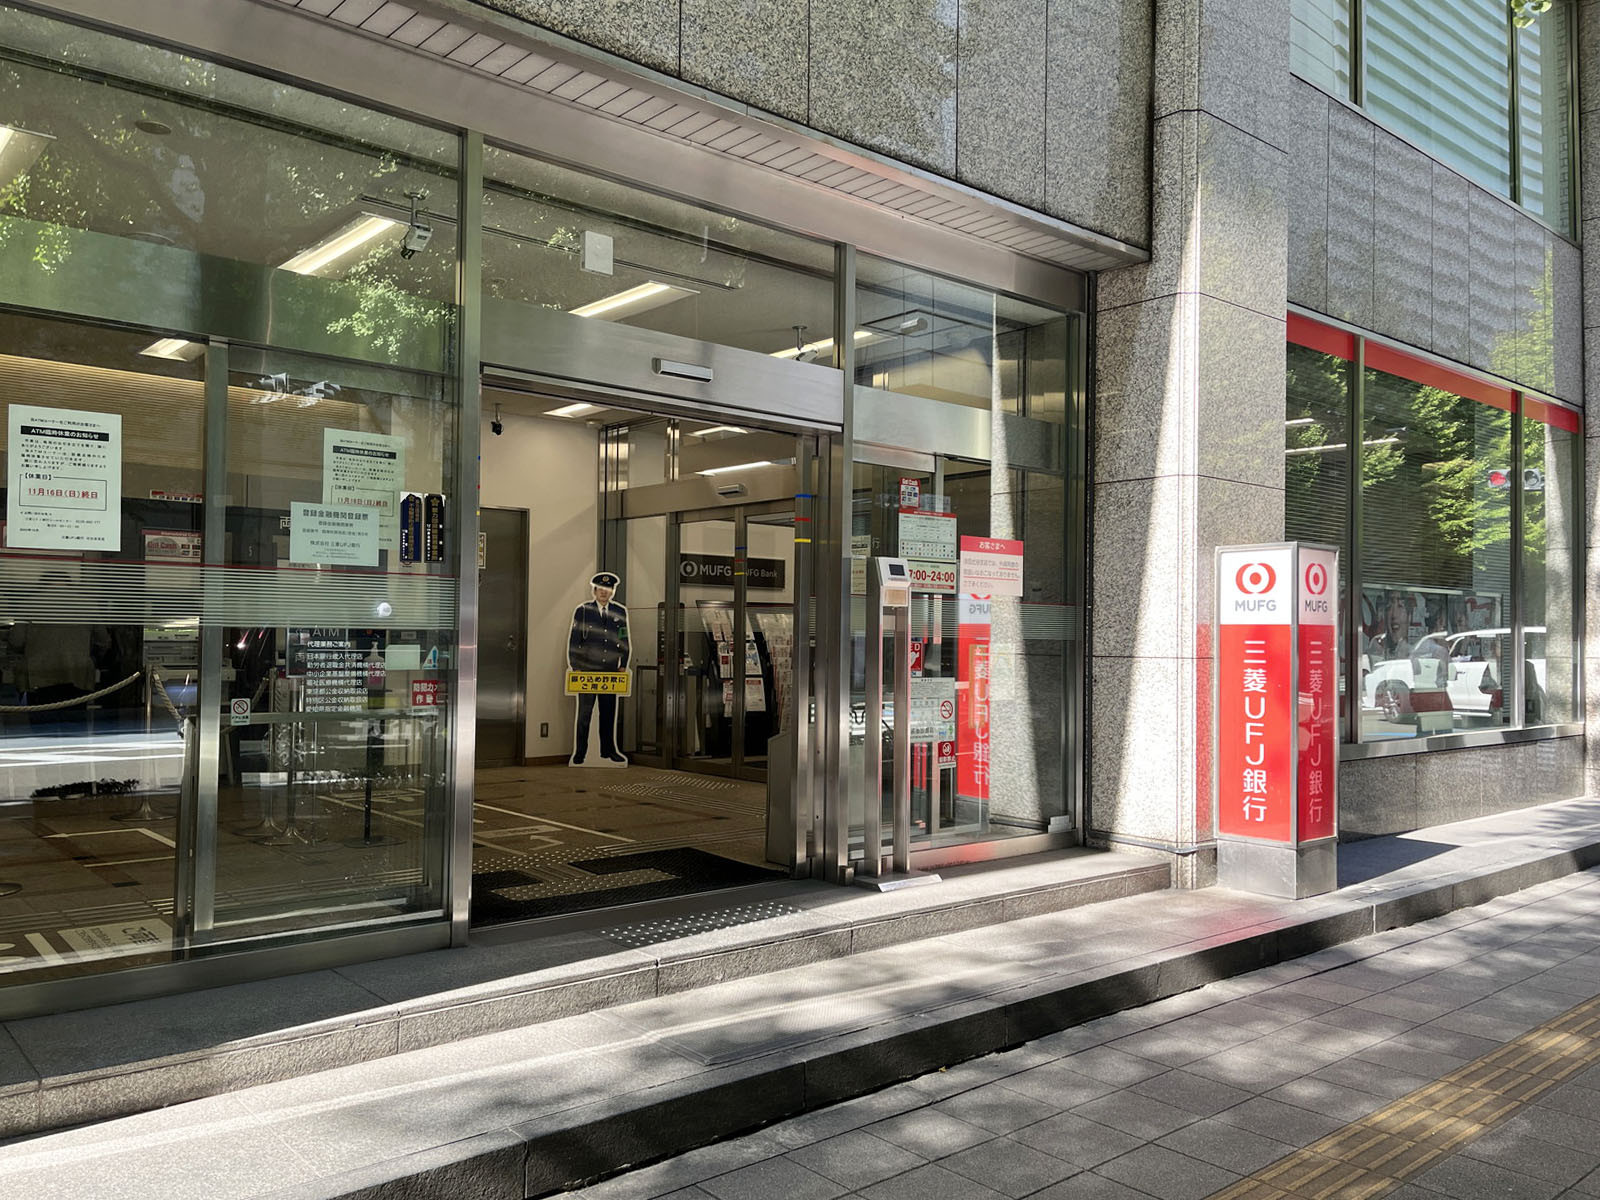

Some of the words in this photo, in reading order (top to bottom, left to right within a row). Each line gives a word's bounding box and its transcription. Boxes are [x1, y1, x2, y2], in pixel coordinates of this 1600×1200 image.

[31, 428, 99, 440] ATM臨時休業のお知らせ
[979, 541, 1006, 550] お客さまへ
[700, 564, 732, 576] MUFG
[760, 569, 777, 578] Bank
[1235, 599, 1277, 612] MUFG
[1305, 600, 1328, 613] MUFG
[571, 675, 625, 683] 振り込め詐欺に
[1243, 640, 1268, 823] 三菱UFJ銀行
[1308, 640, 1324, 824] 三菱UFJ銀行
